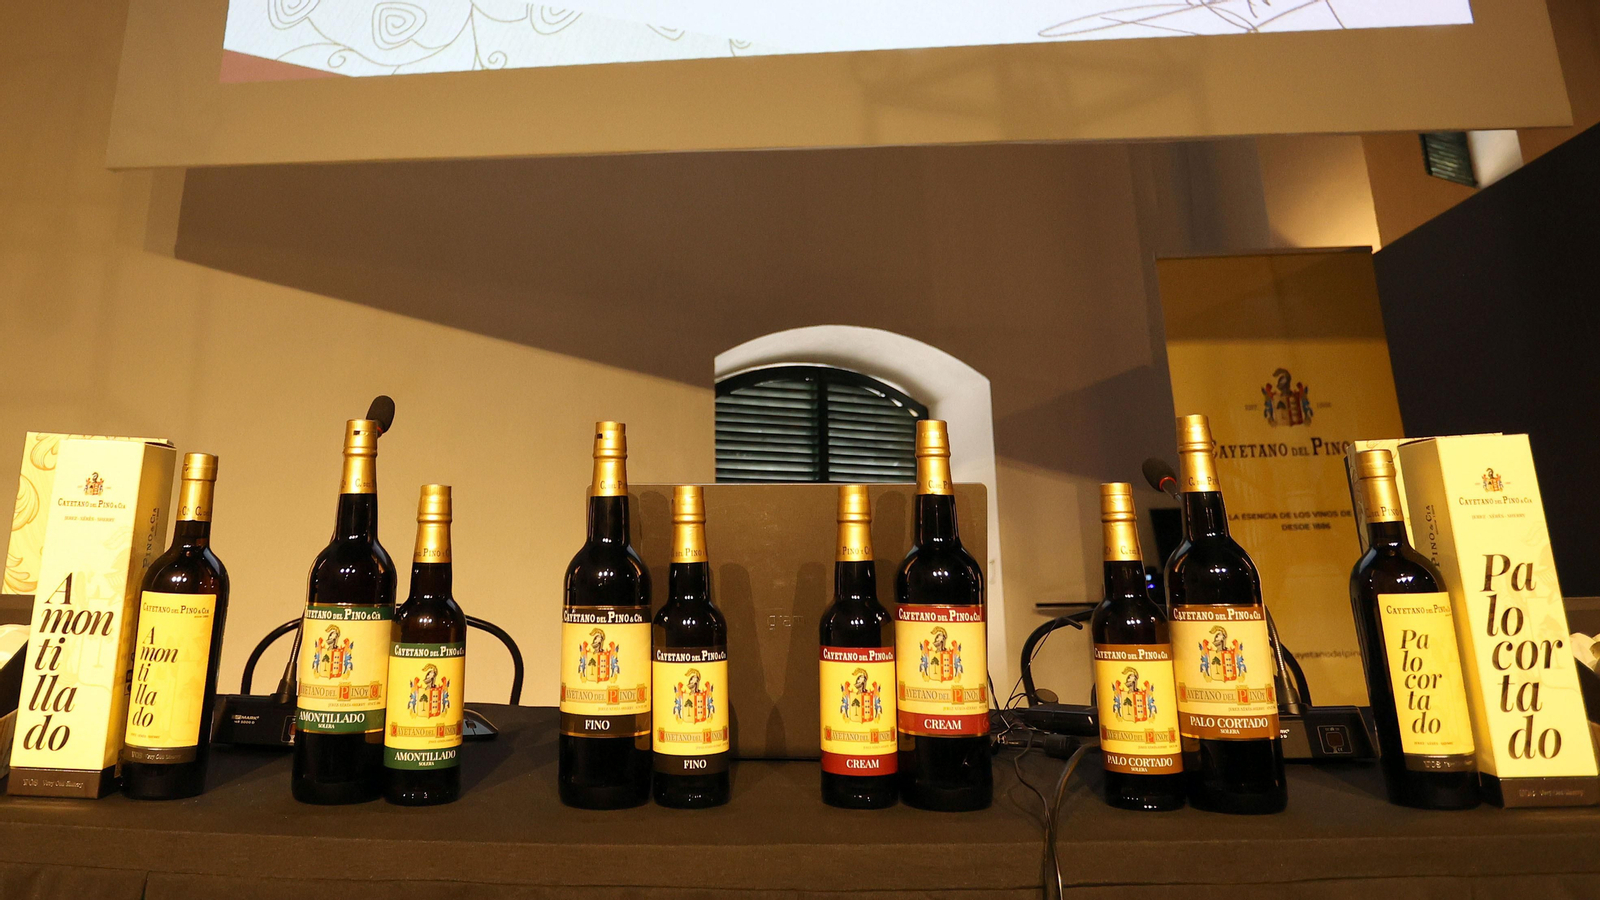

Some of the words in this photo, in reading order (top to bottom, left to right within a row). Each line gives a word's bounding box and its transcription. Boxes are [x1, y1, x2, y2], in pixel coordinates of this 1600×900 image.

[1291, 446, 1309, 456] DEL
[58, 498, 89, 507] CAYETANO
[98, 500, 114, 508] PINO
[1458, 497, 1494, 506] CAYETANO
[1502, 495, 1520, 504] PINO
[1242, 512, 1278, 520] ESENCIA
[1293, 511, 1311, 519] LOS
[1312, 510, 1338, 518] VINOS
[1282, 523, 1311, 531] DESDE
[1479, 554, 1537, 593] Pa
[44, 572, 73, 605] A
[143, 602, 170, 613] CAYETANO
[180, 605, 197, 614] PINO
[344, 609, 367, 620] PINO
[898, 608, 936, 621] CAYETANO
[949, 609, 969, 621] PINO
[1173, 608, 1214, 621] CAYETANO
[1227, 608, 1250, 620] PINO
[1386, 605, 1425, 615] CAYETANO
[39, 608, 114, 636] mon
[608, 611, 629, 623] PINO
[1486, 594, 1524, 637] lo
[142, 626, 155, 645] A
[1399, 629, 1430, 650] Pa
[34, 637, 66, 671] ti
[140, 645, 179, 663] mon
[394, 645, 429, 657] CAYETANO
[440, 646, 457, 656] PINO
[656, 650, 691, 661] CAYETANO
[701, 650, 718, 661] PINO
[823, 648, 858, 661] CAYETANO
[868, 650, 886, 661] PINO
[1095, 648, 1126, 659] CAYETANO
[1138, 649, 1158, 659] PINO
[1491, 639, 1564, 671] cor
[1401, 649, 1423, 673] lo
[138, 663, 151, 682] ti
[1404, 673, 1443, 690] cor
[28, 674, 78, 712] lla
[135, 683, 158, 706] lla
[1497, 674, 1543, 713] ta
[1407, 690, 1432, 711] ta
[132, 707, 154, 728] do
[299, 711, 365, 724] AMONTILLADO
[1190, 716, 1215, 728] PALO
[1217, 717, 1268, 729] CORTADO
[1411, 711, 1442, 735] do
[585, 720, 610, 730] FINO
[924, 719, 962, 730] CREAM
[23, 714, 71, 751] do
[1508, 714, 1562, 760] do
[394, 750, 456, 761] AMONTILLADO
[1107, 755, 1127, 766] PALO
[1128, 757, 1173, 767] CORTADO
[684, 759, 707, 769] FINO
[846, 759, 880, 769] CREAM
